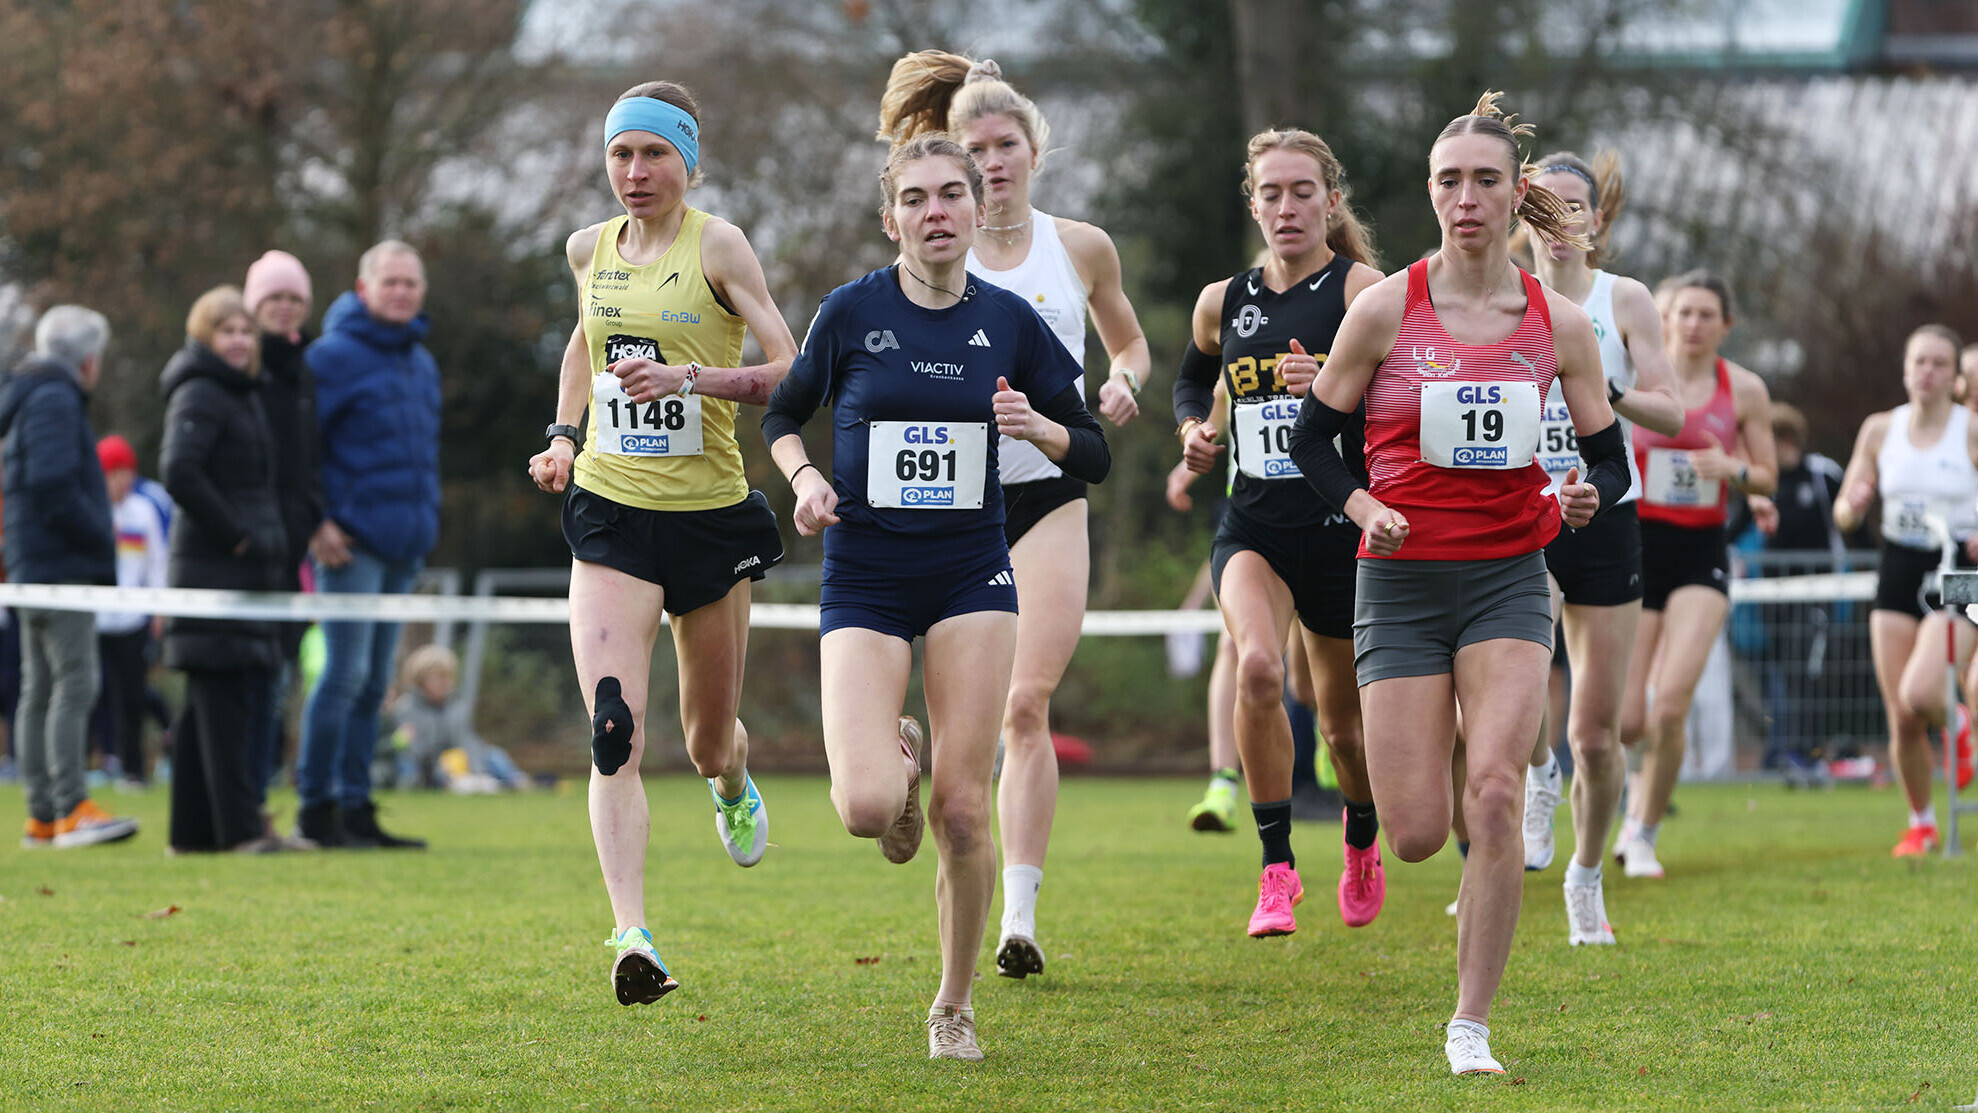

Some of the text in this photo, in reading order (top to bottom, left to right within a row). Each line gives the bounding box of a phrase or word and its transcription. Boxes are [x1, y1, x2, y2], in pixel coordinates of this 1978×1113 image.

[661, 310, 701, 325] EnBW
[610, 343, 657, 360] HOKA
[910, 361, 965, 376] VIACTIV
[607, 398, 686, 431] 1148
[1461, 410, 1504, 442] 19
[640, 438, 668, 448] PLAN
[1258, 424, 1293, 454] 10
[1475, 450, 1506, 460] PLAN
[895, 449, 957, 482] 691
[922, 490, 953, 500] PLAN
[734, 555, 762, 575] HOKA
